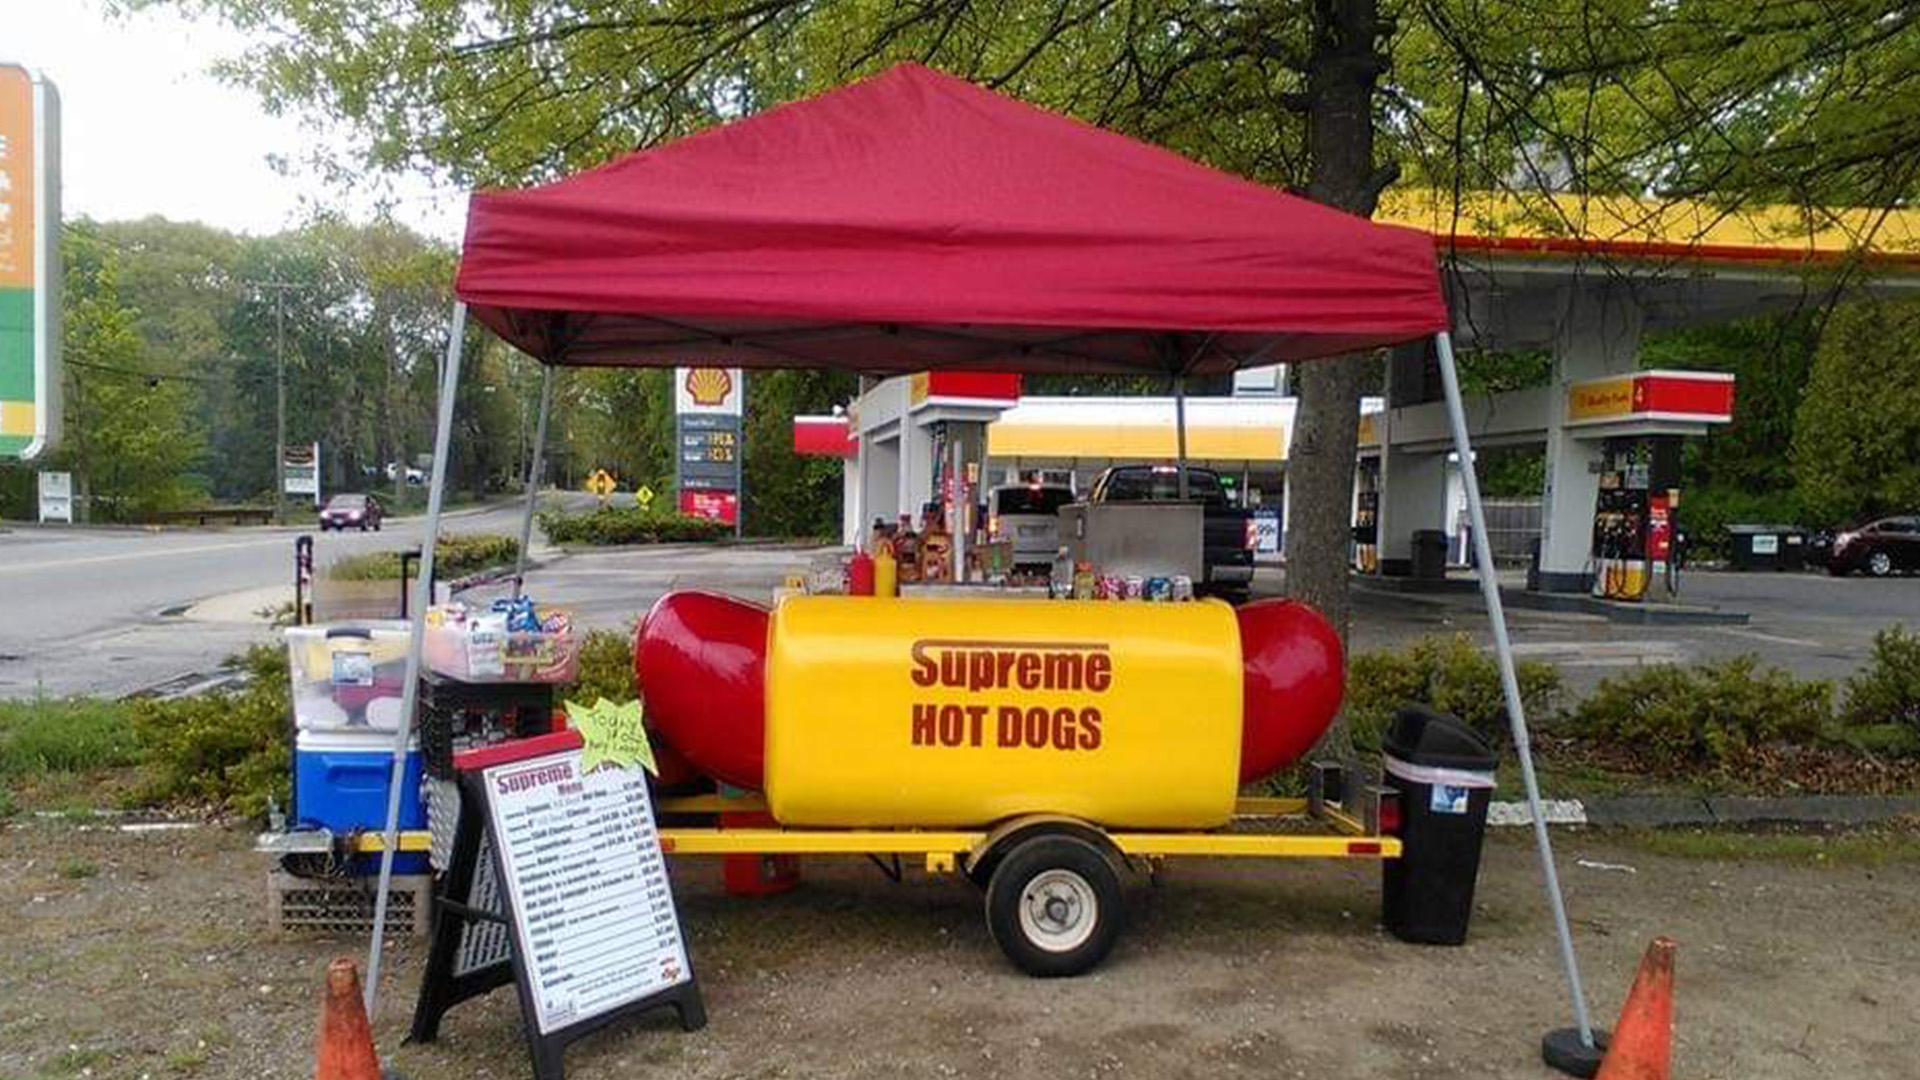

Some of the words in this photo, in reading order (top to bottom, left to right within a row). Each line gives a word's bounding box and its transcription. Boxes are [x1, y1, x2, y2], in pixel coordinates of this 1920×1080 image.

[911, 639, 1112, 692] Supreme
[911, 704, 989, 748] HOT
[997, 706, 1102, 751] DOGS
[496, 761, 573, 796] Supreme
